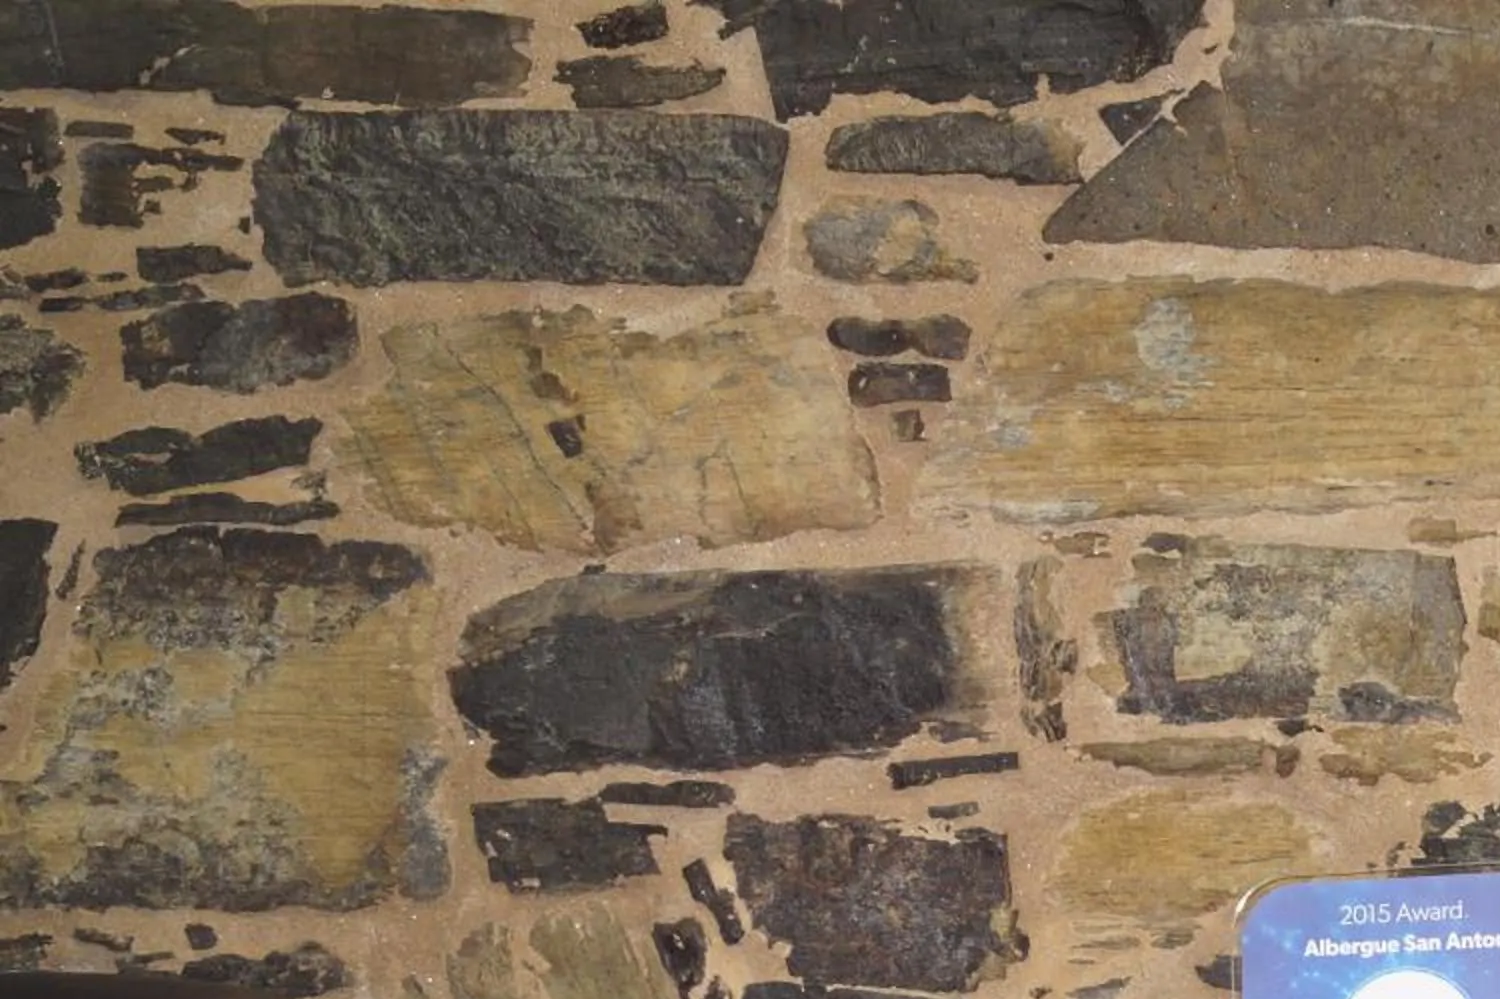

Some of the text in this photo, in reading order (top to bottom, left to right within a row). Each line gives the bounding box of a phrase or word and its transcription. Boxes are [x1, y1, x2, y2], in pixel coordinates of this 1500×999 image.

[1340, 904, 1391, 925] 2015
[1304, 939, 1400, 958] Albergue
[1403, 934, 1441, 951] San
